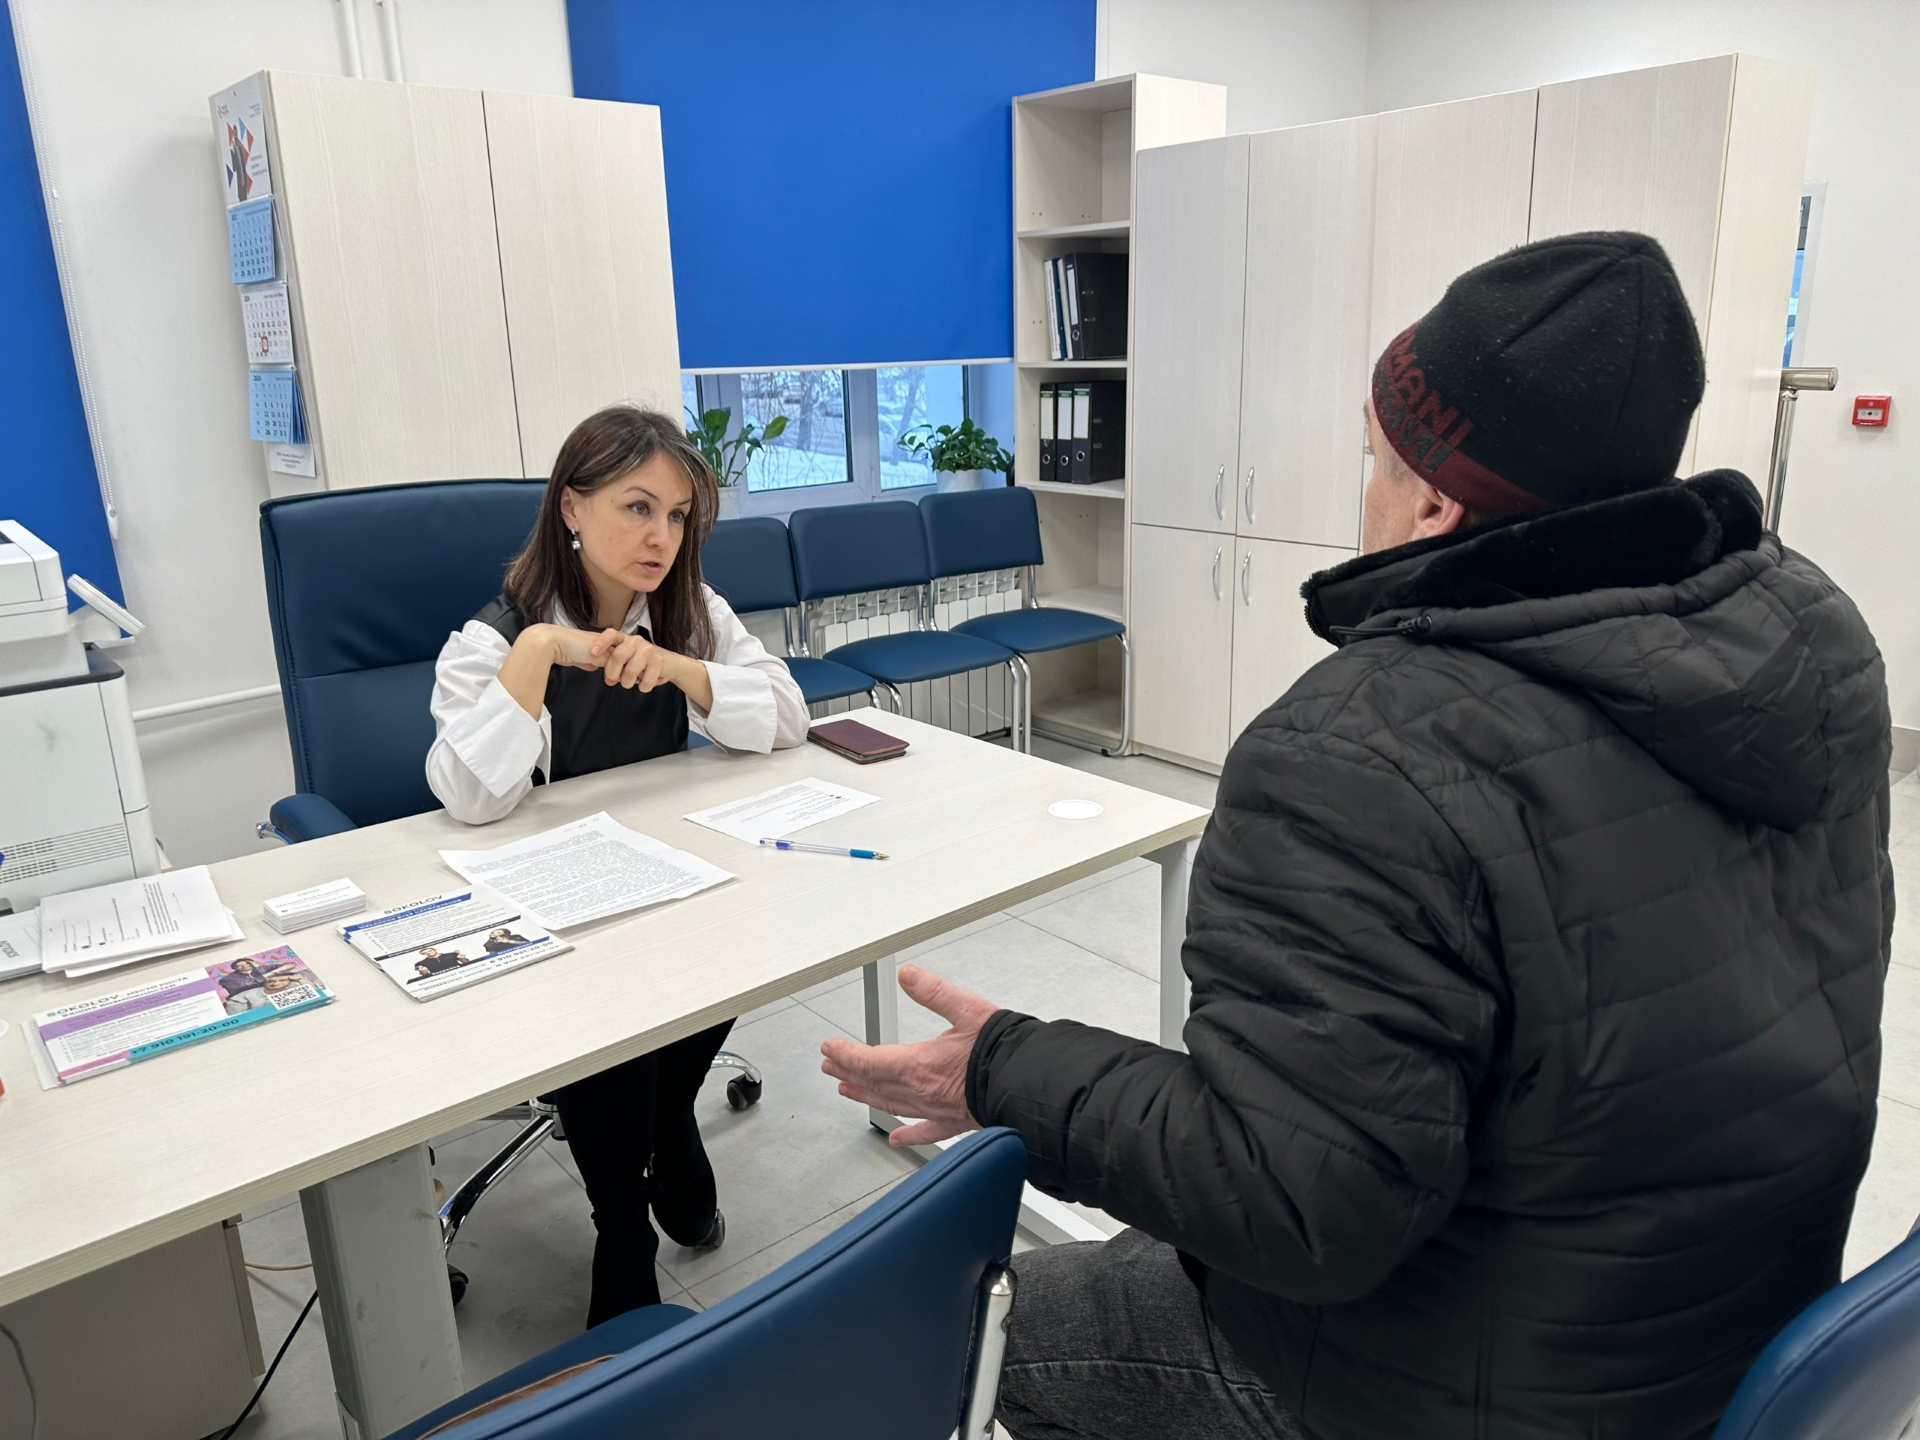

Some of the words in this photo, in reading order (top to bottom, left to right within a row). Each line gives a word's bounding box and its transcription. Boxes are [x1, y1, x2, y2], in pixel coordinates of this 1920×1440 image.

[383, 894, 442, 915] SOKOLOV
[46, 994, 119, 1017] SOKOLOV
[150, 1038, 174, 1049] 910
[177, 1018, 240, 1042] 191-20-00
